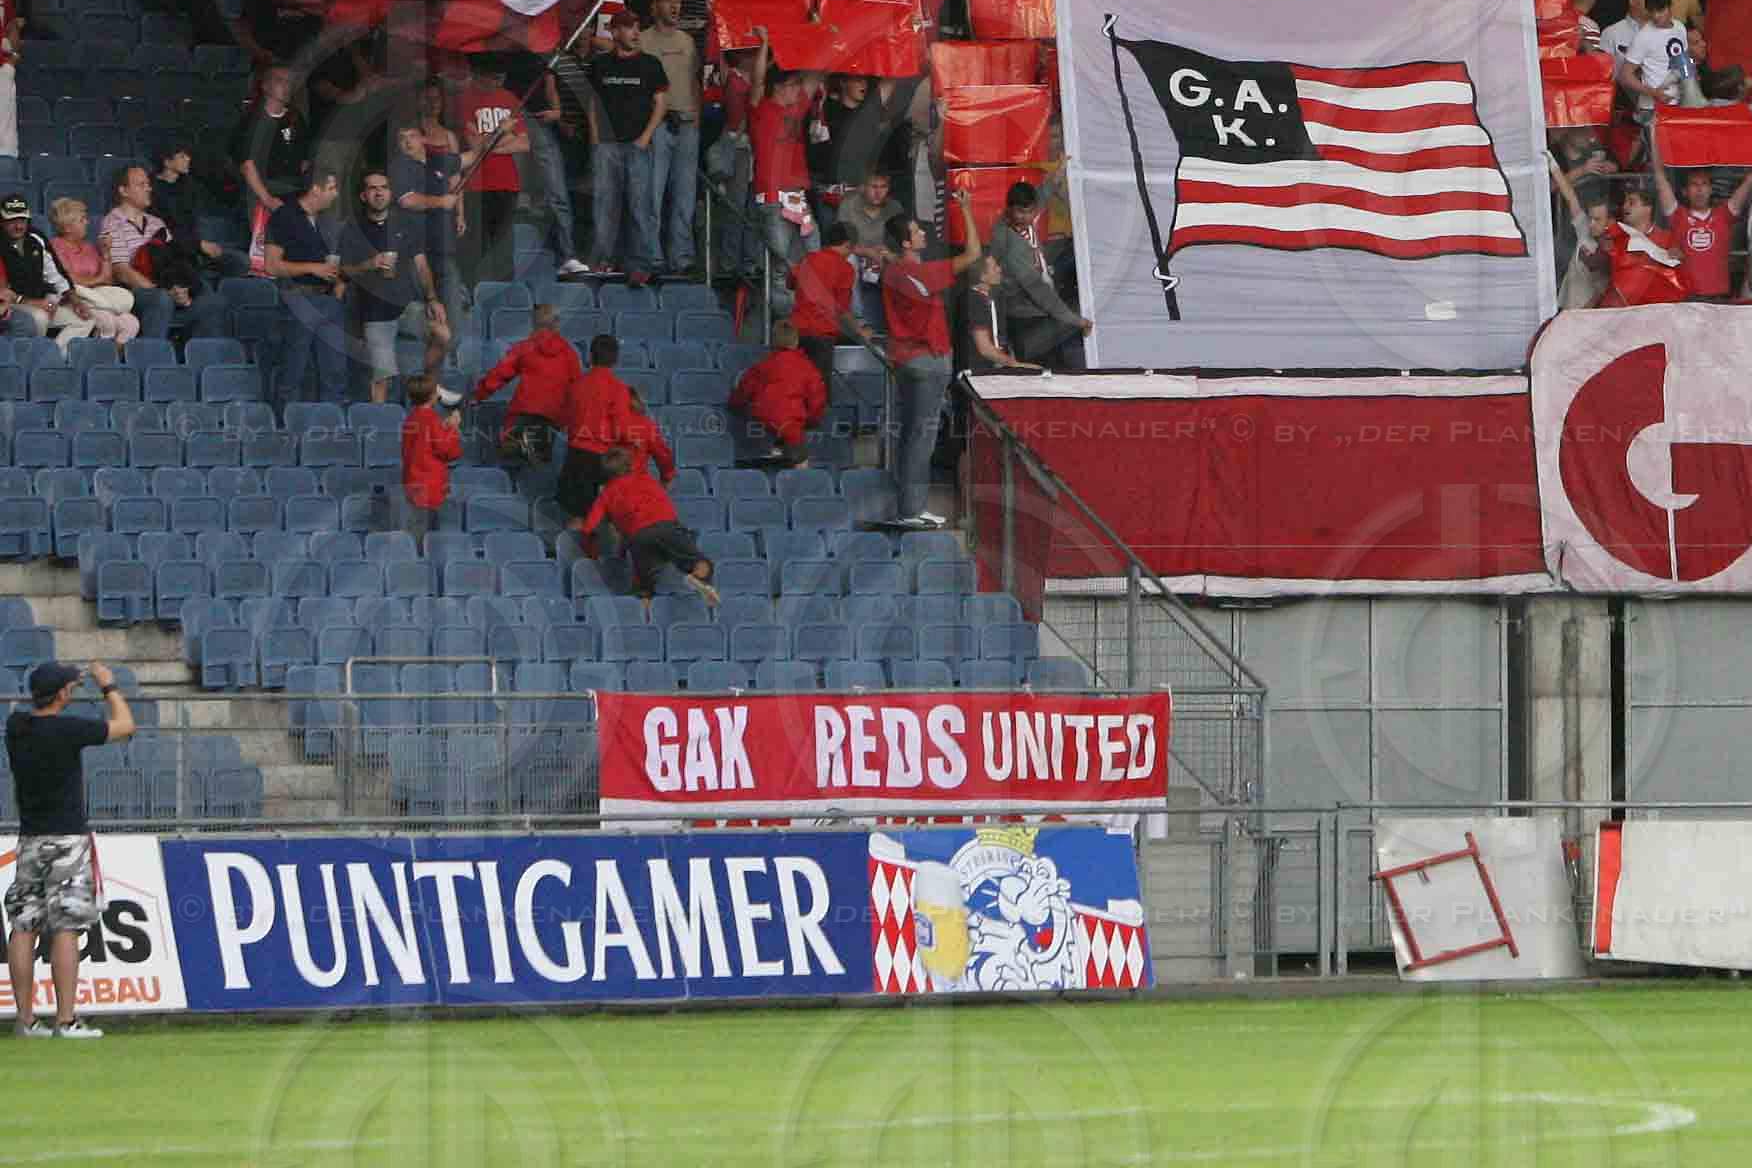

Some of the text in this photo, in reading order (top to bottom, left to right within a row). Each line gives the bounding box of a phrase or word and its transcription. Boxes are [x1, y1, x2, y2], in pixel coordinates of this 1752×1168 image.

[642, 703, 1157, 793] GAK REDS UNITED
[202, 850, 847, 991] PUNTIGAMER
